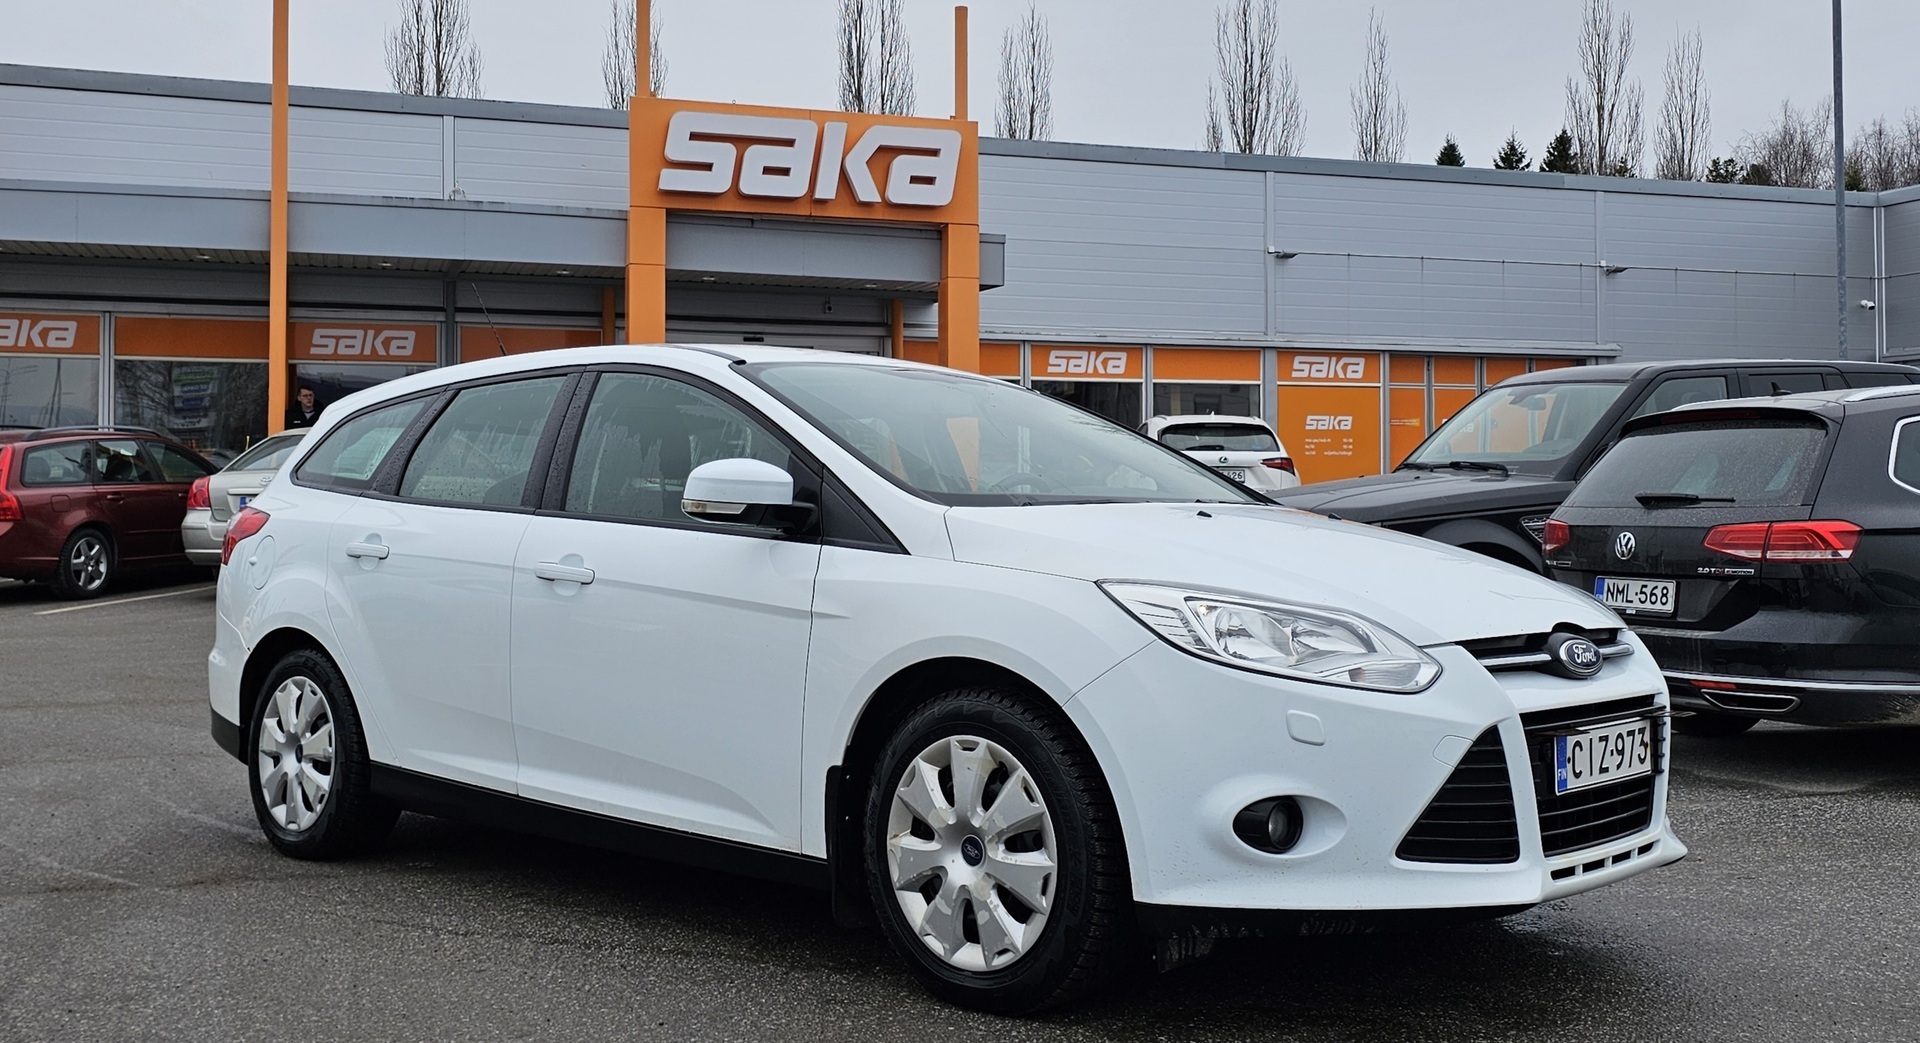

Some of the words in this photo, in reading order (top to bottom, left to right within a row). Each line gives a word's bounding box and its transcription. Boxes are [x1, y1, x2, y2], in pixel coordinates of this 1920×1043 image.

[0, 319, 77, 348] aka
[1606, 582, 1669, 606] NML-568
[1572, 644, 1597, 664] Ford
[1571, 726, 1648, 779] CIZ-973
[1558, 768, 1567, 781] FIN
